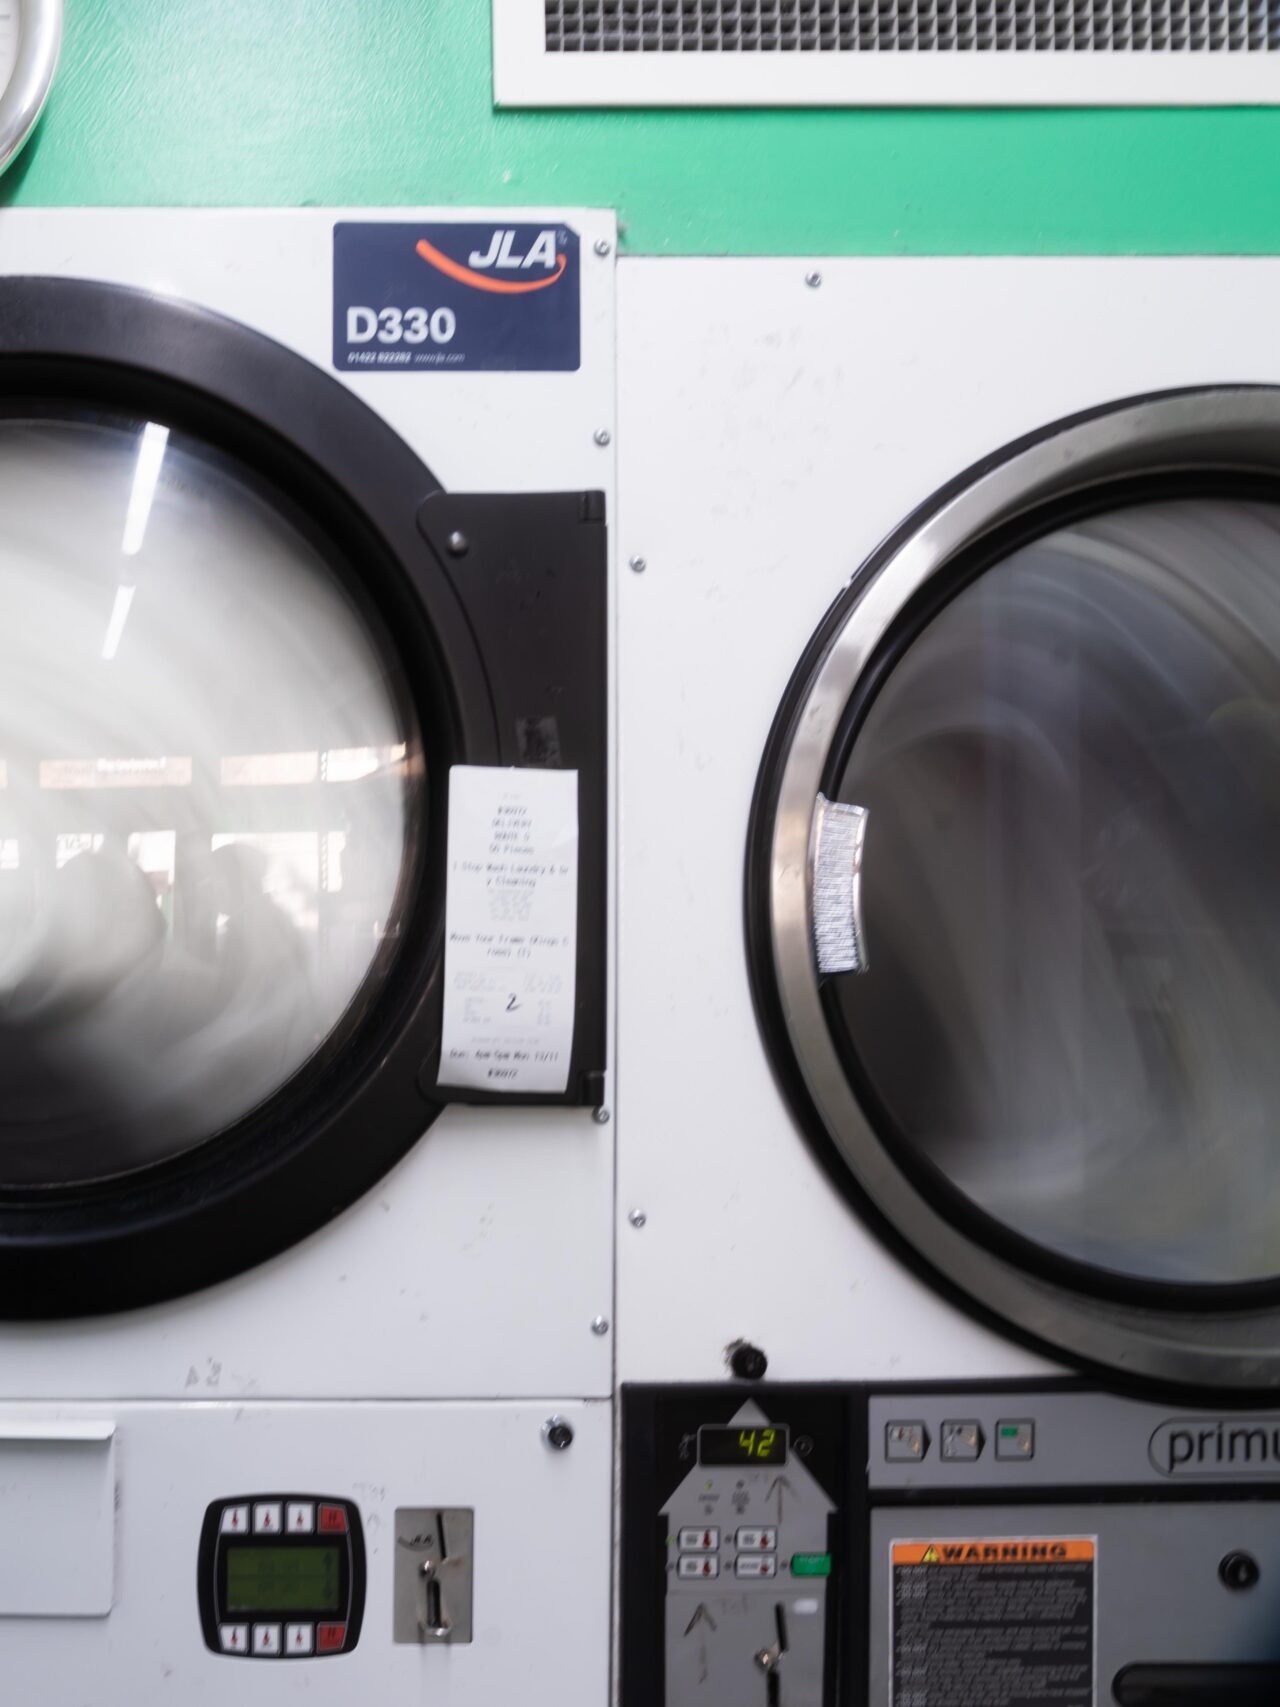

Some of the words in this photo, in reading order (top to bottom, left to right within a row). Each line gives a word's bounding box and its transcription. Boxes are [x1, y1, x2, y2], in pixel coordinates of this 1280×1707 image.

[468, 230, 557, 269] JLA
[346, 306, 457, 345] D330
[504, 992, 523, 1013] 2
[739, 1428, 776, 1457] 42
[942, 1542, 1067, 1561] WARNING
